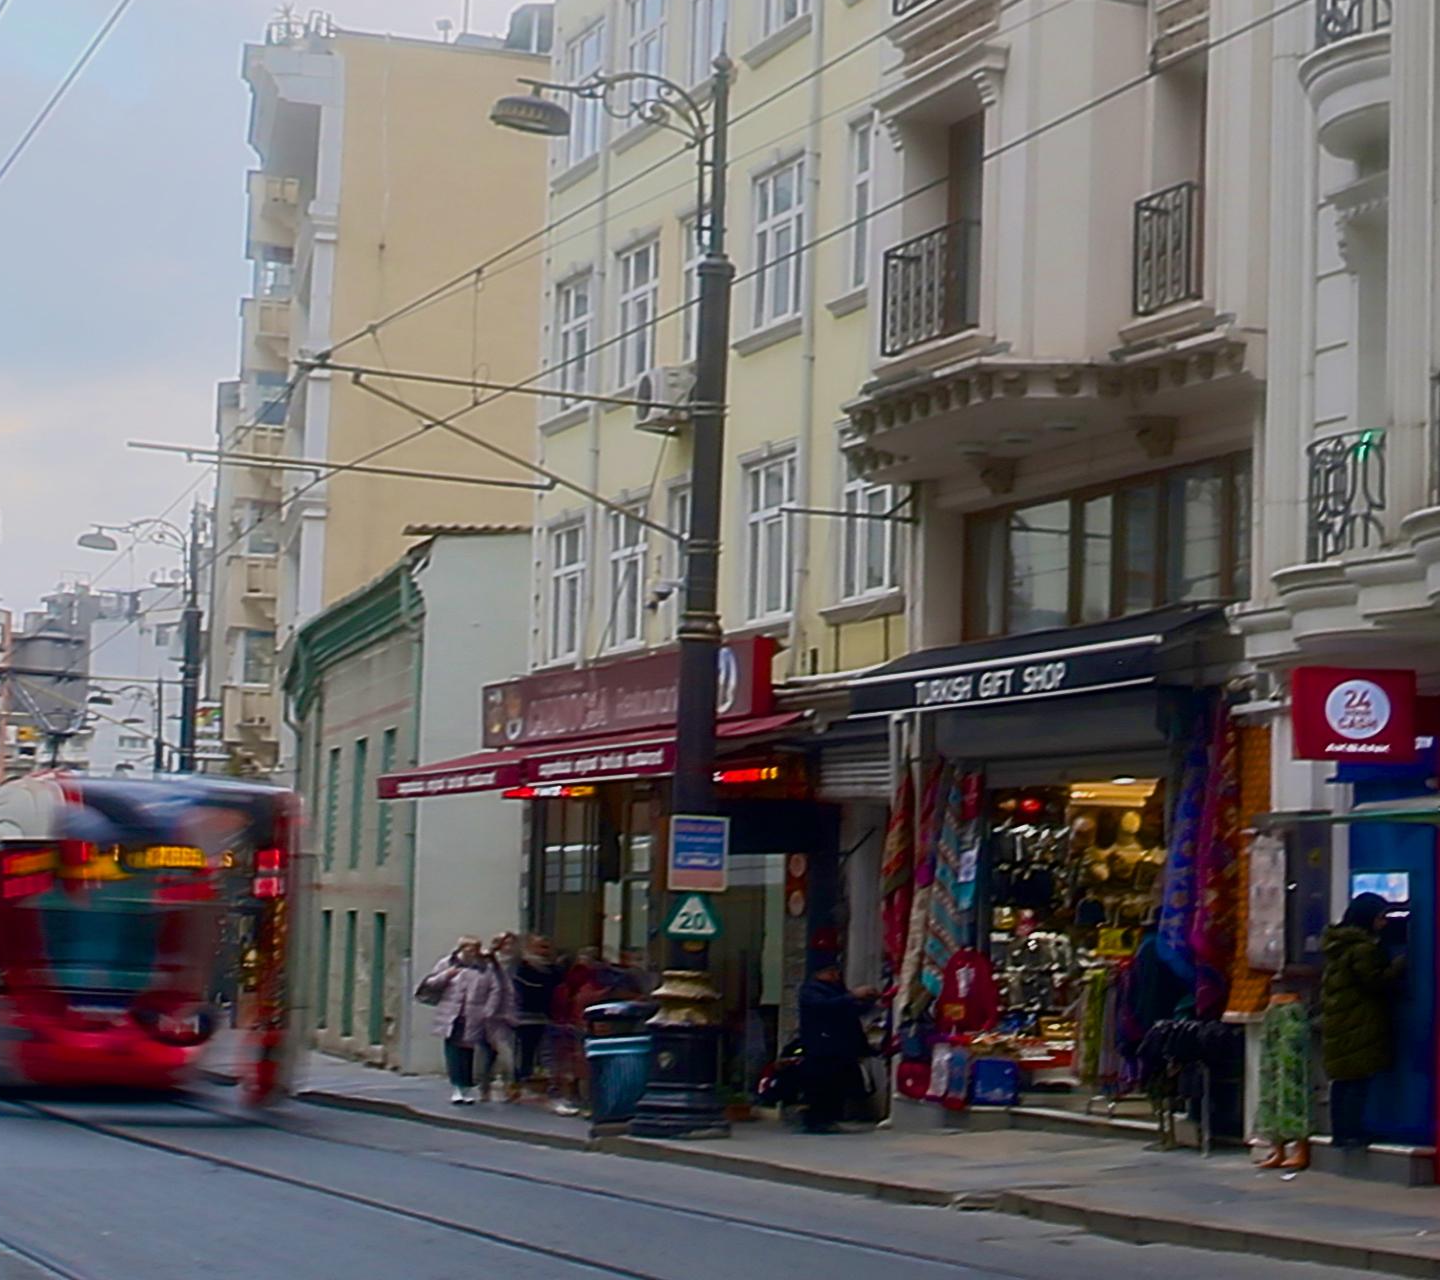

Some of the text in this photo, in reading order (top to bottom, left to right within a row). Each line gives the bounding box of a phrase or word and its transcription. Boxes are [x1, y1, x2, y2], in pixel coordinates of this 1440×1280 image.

[914, 661, 1066, 706] TURKISH GIFT SHOP
[679, 912, 705, 930] 20
